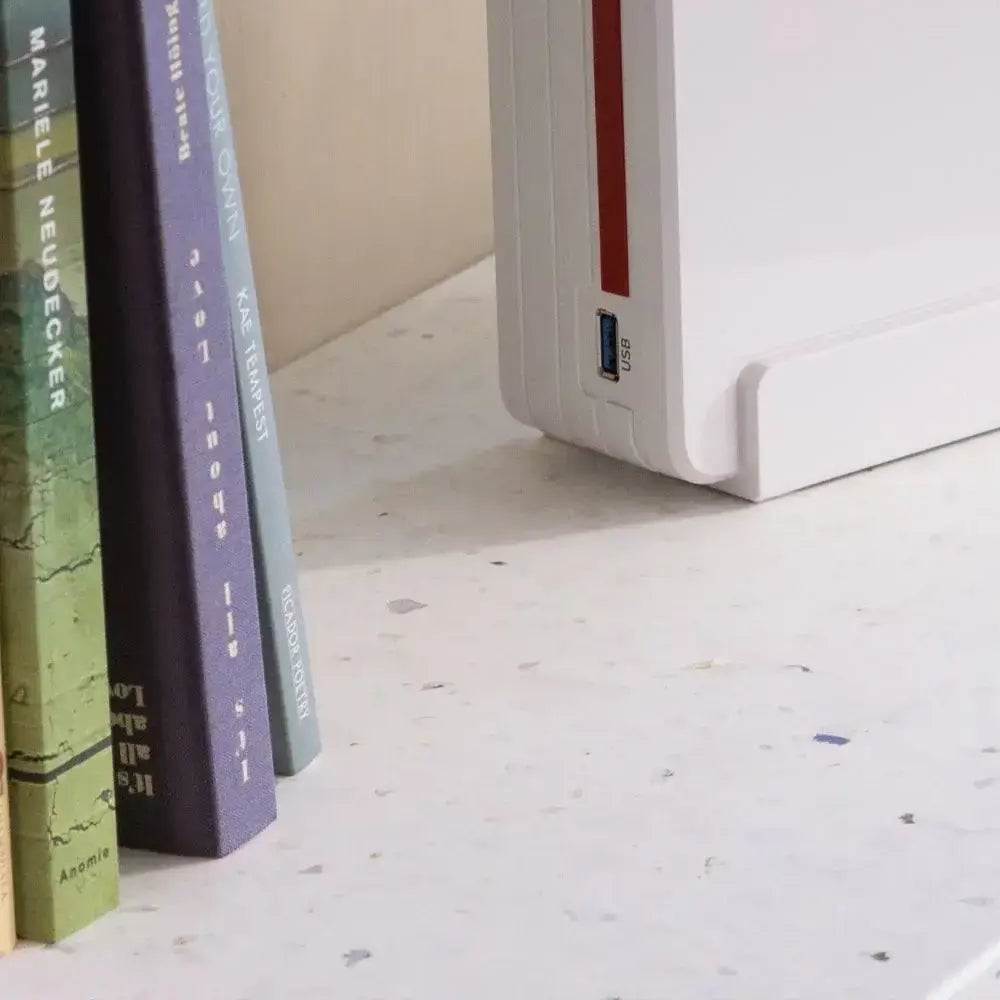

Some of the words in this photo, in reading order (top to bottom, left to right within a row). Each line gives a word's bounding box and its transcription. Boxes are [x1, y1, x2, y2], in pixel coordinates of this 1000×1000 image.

[30, 26, 53, 181] MARIELE
[204, 44, 225, 137] YOUR
[218, 148, 241, 241] OWN
[39, 195, 67, 411] NEUDECKER
[236, 287, 252, 336] KAE
[244, 340, 269, 441] TEMPEST
[621, 338, 631, 372] USB
[281, 584, 300, 655] PICADOR
[292, 660, 310, 719] POETRY
[60, 847, 109, 884] Anomie
